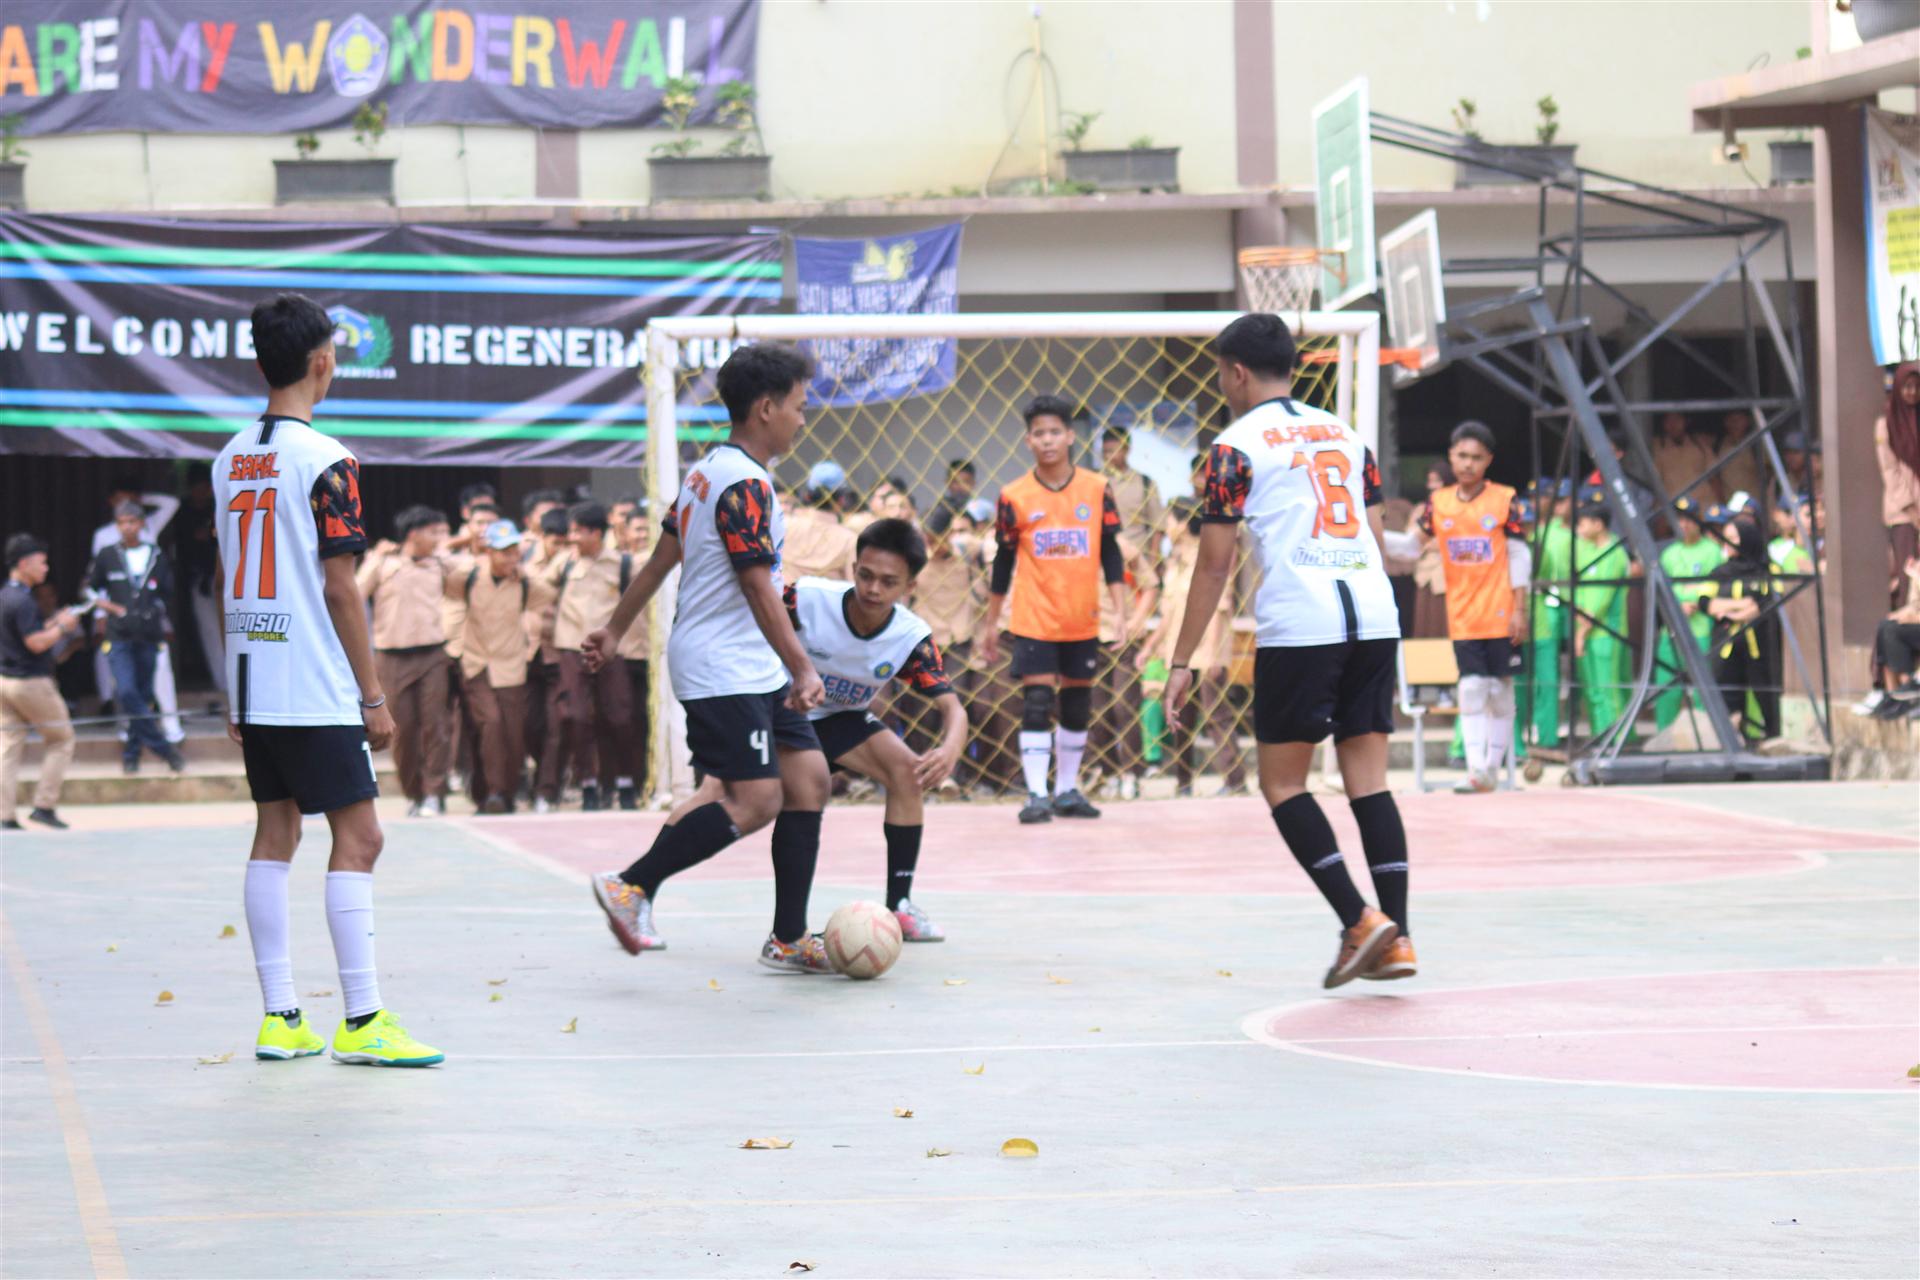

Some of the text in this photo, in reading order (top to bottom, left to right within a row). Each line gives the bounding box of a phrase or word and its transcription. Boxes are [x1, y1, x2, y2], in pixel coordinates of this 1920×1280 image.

[0, 18, 119, 96] ARE
[138, 18, 238, 93] MY
[228, 488, 278, 600] 11
[750, 729, 770, 766] 4
